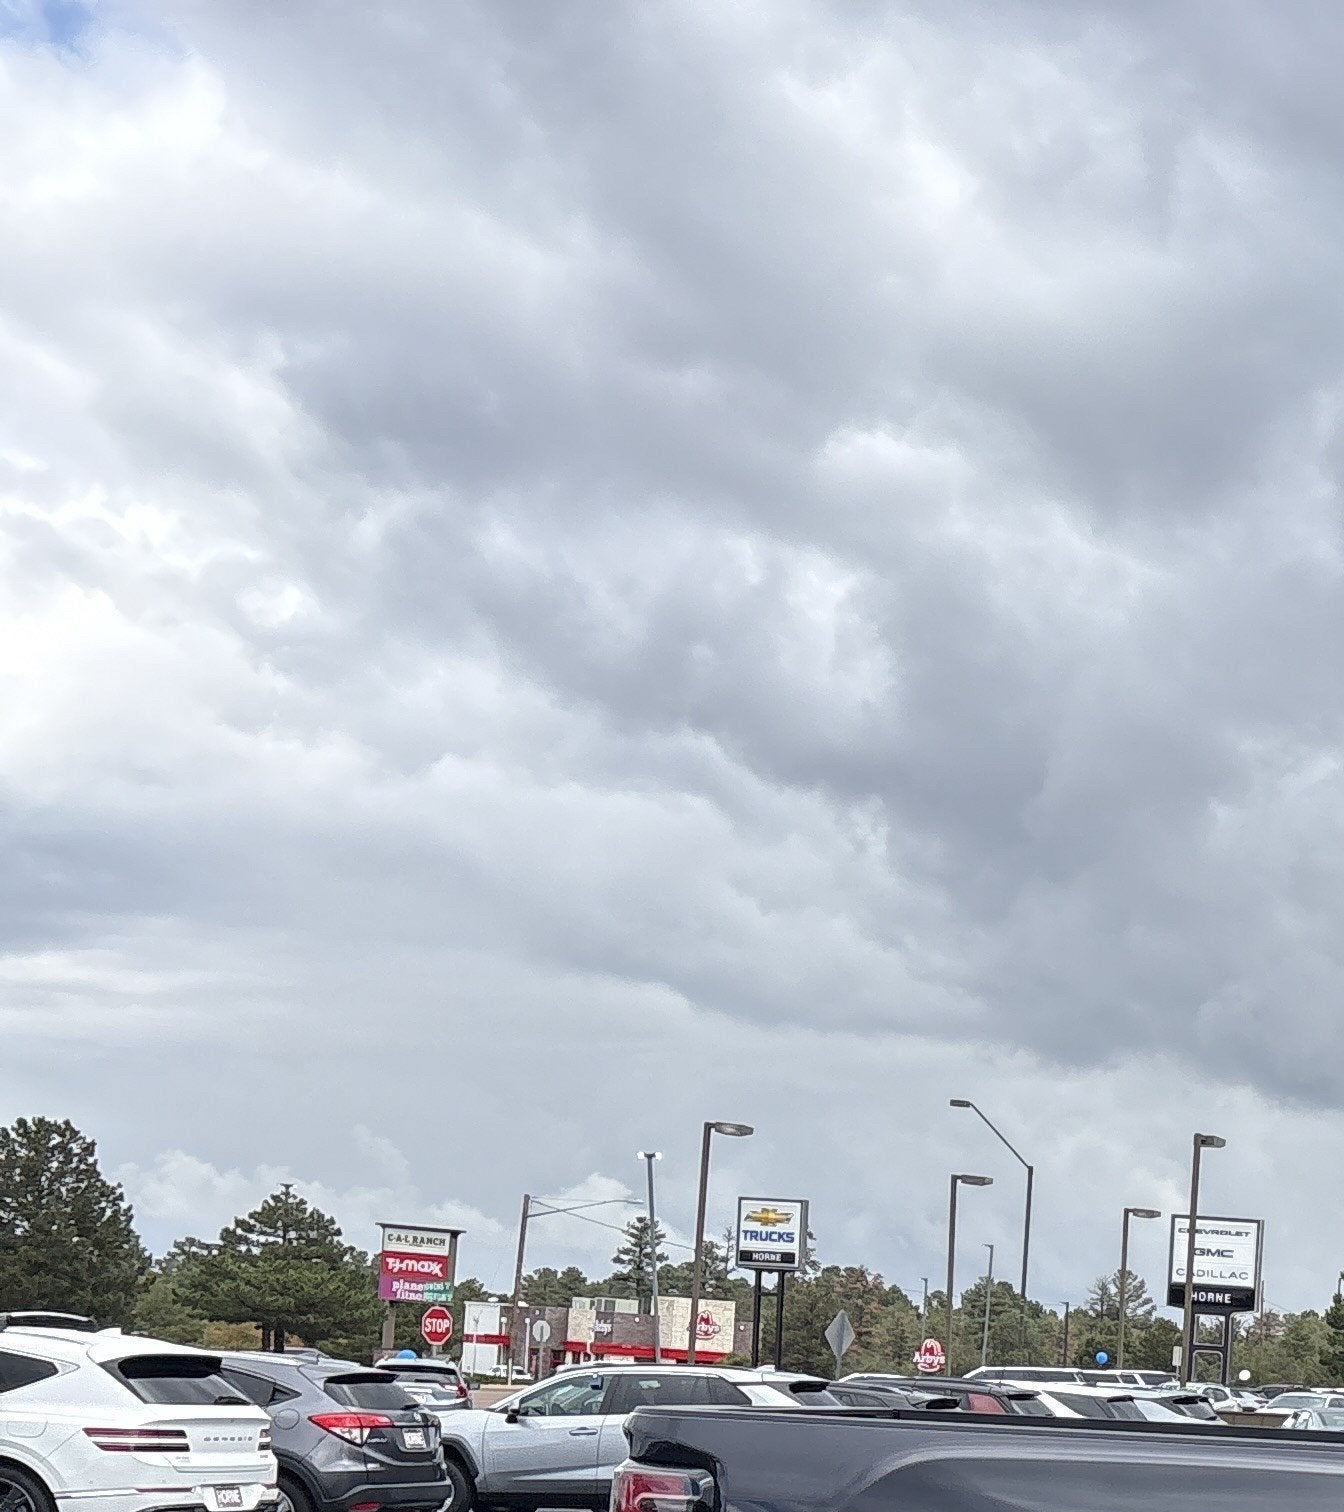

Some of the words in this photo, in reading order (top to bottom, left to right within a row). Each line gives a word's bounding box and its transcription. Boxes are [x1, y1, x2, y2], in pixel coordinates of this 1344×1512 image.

[412, 1235, 446, 1246] RANCH
[742, 1229, 795, 1243] TRUCKS
[752, 1252, 781, 1262] HORNE
[1194, 1247, 1234, 1259] GMC
[1175, 1267, 1249, 1280] CDILLAC
[1191, 1291, 1232, 1304] HORNE
[424, 1317, 450, 1333] STOP
